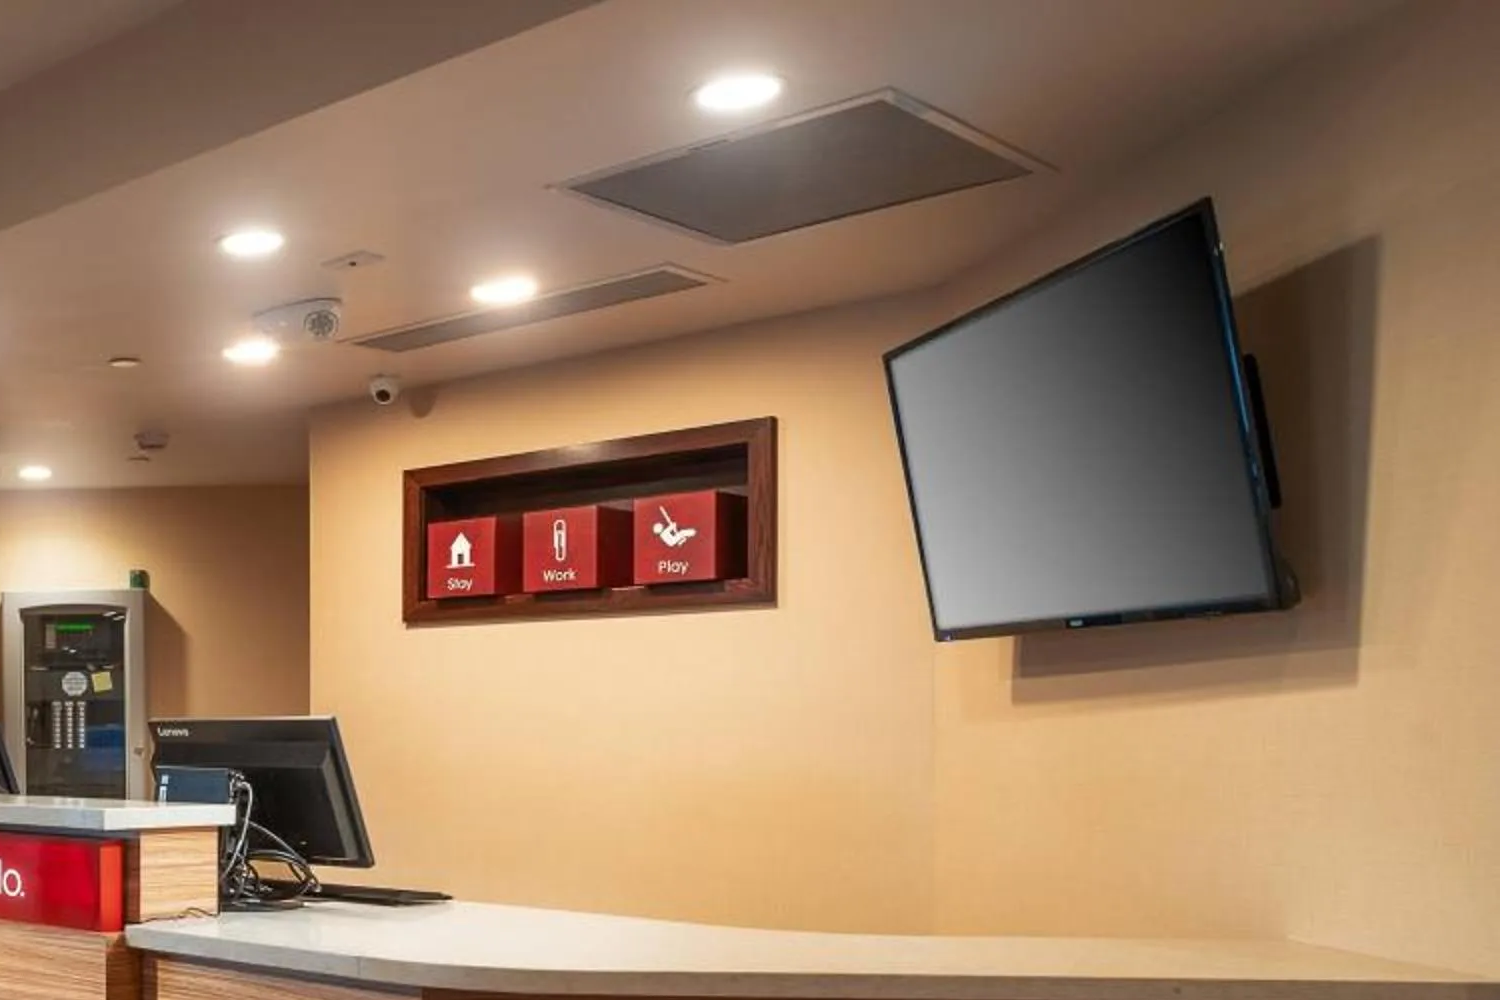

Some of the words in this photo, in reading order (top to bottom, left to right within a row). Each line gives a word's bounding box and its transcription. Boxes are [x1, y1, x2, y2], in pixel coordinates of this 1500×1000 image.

[659, 559, 689, 576] Play
[543, 568, 577, 582] Work
[447, 577, 473, 591] Stay
